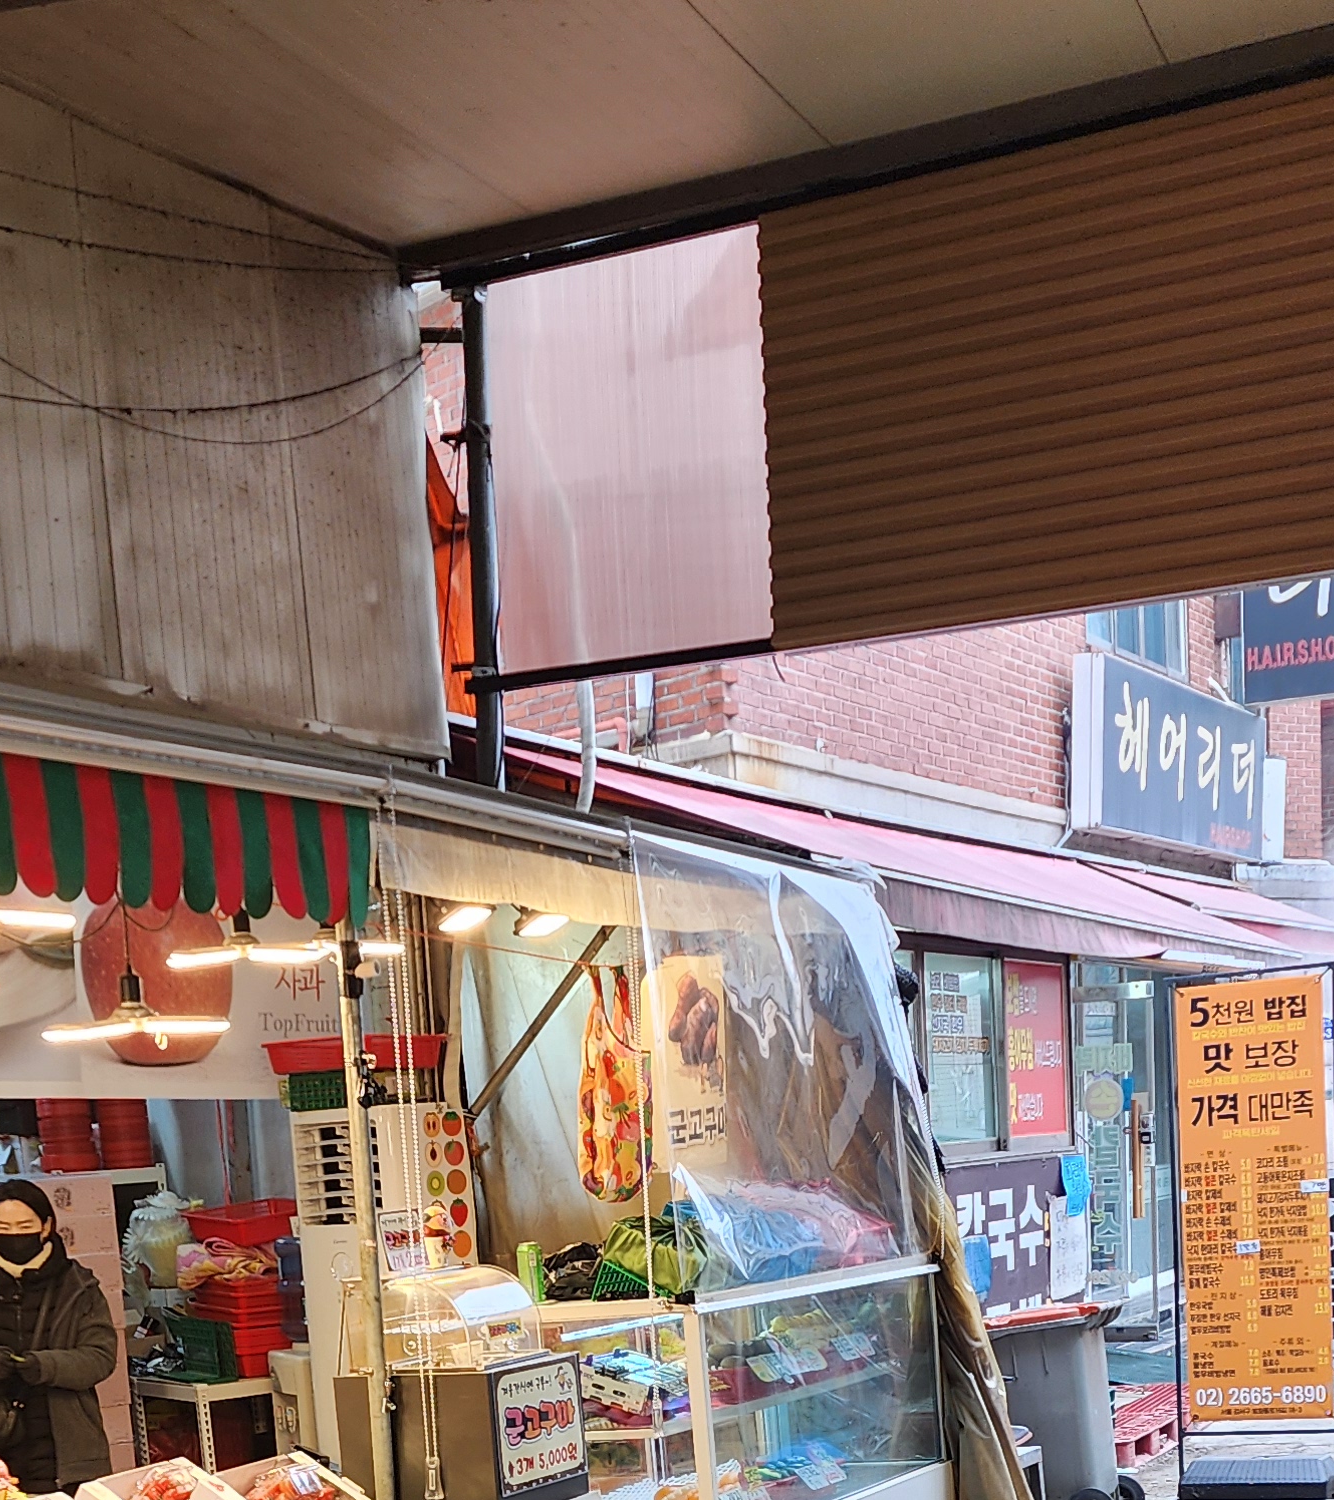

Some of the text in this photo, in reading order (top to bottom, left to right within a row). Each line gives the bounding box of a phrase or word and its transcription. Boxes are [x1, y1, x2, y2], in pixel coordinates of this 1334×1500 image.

[1114, 680, 1256, 821] 헤어리더
[274, 962, 327, 1002] 사과
[258, 1011, 339, 1038] TopFruit
[1190, 994, 1307, 1028] 5천원 밥집
[1203, 1039, 1299, 1074] 맛 보장
[1191, 1090, 1315, 1128] 가격 대만족
[1195, 1384, 1327, 1407] 02) 2665-6890
[504, 1397, 576, 1447] 군고구마
